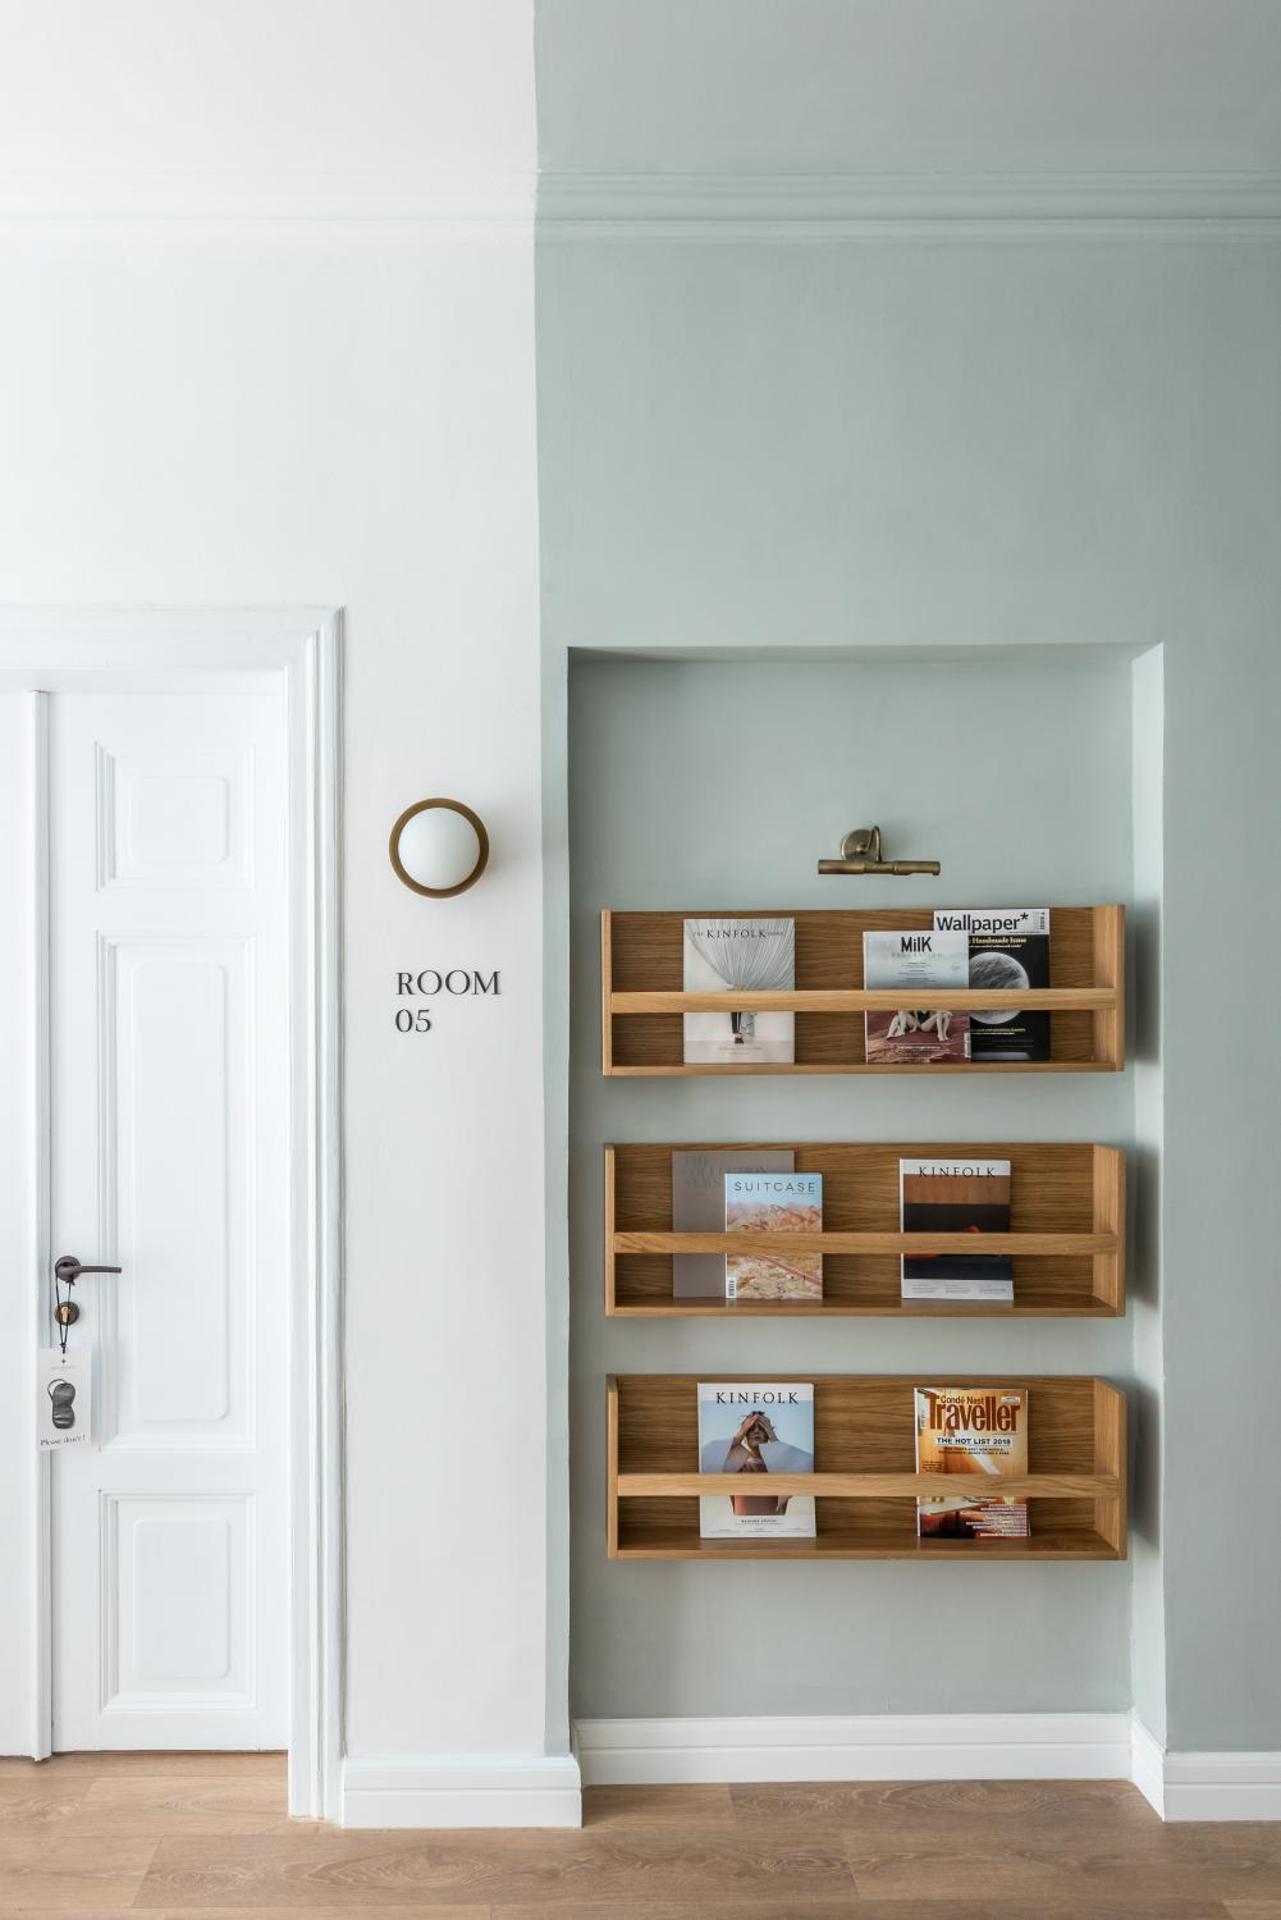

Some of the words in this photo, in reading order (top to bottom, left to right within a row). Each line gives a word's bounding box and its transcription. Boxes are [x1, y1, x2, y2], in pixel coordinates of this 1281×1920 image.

[707, 929, 767, 938] KINFOLK
[901, 936, 932, 952] MilK
[395, 969, 502, 995] ROOM
[395, 1009, 432, 1032] 05
[918, 1166, 996, 1178] KINFOLK
[734, 1182, 815, 1192] SUITCASE
[716, 1392, 799, 1404] KINFOLK
[967, 1396, 984, 1404] Nast
[925, 1393, 1020, 1431] Traveller
